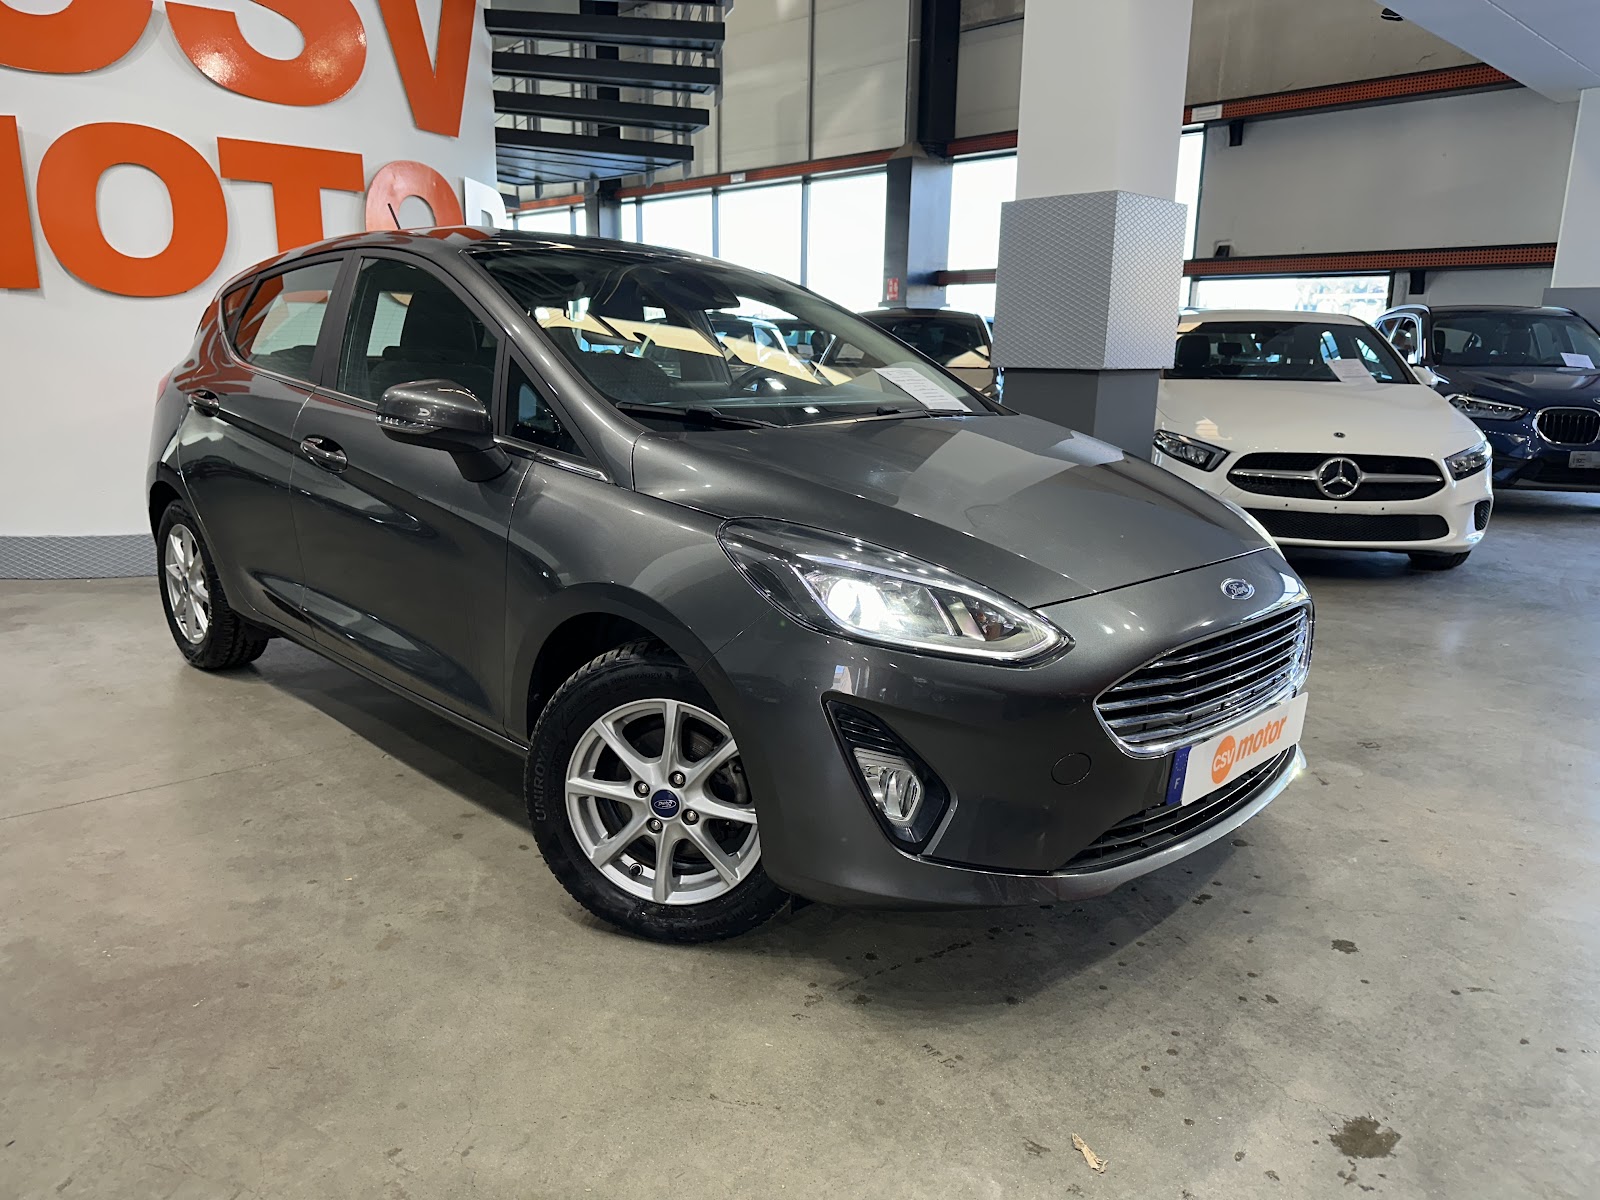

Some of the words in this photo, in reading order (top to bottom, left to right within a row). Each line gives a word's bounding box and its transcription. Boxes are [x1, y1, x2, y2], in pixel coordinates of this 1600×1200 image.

[1235, 716, 1287, 762] motor
[533, 735, 551, 821] UNIROY
[1173, 777, 1181, 790] F
